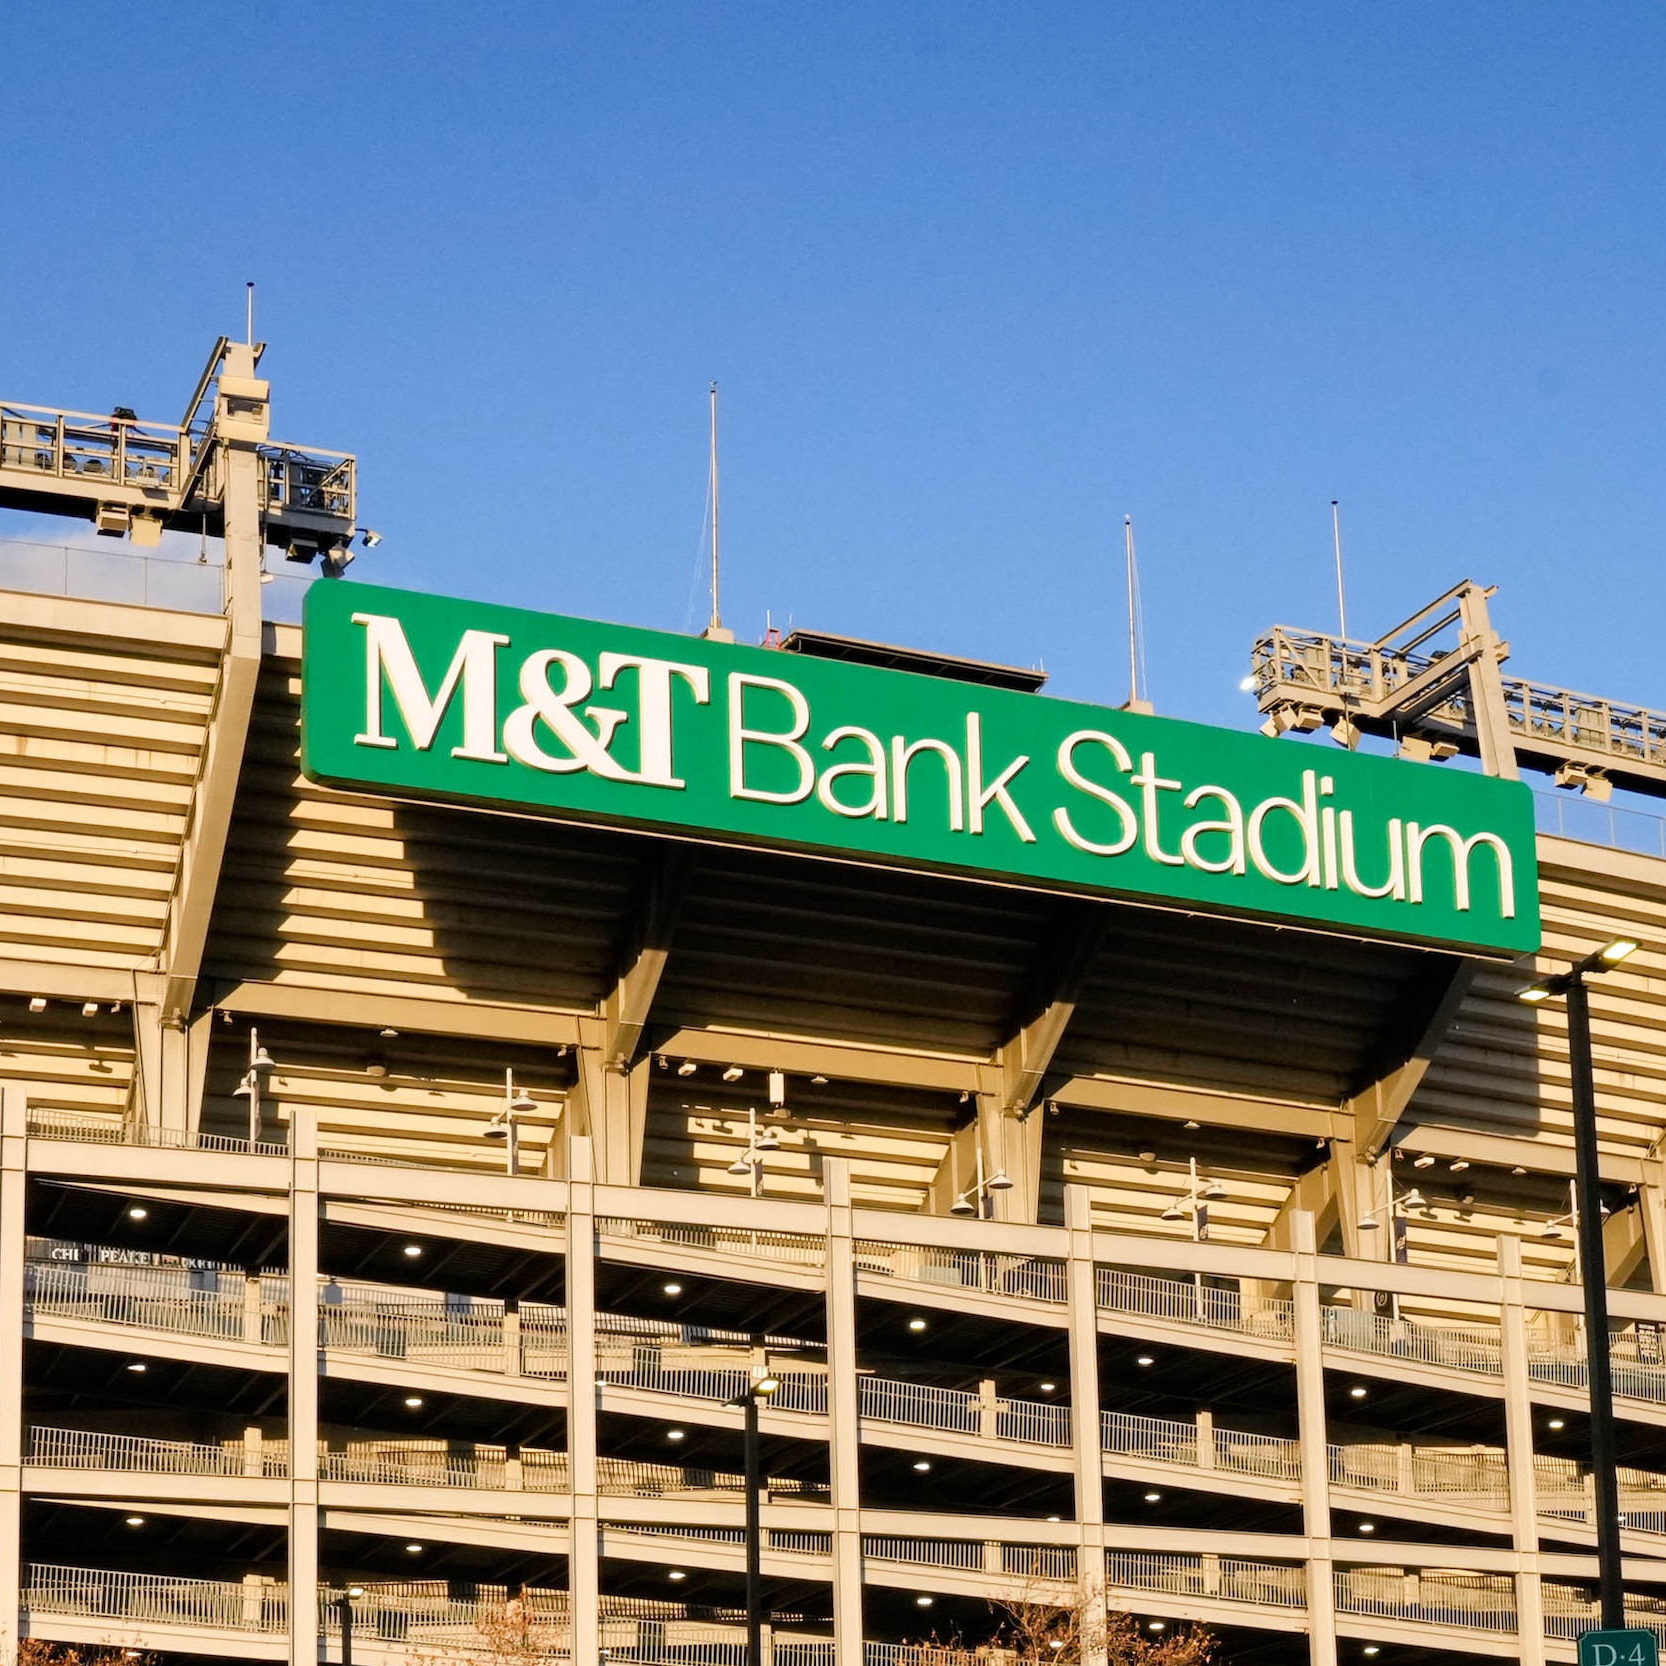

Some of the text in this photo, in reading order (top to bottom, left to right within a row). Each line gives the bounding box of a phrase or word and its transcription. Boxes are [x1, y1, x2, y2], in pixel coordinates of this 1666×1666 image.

[350, 611, 1517, 921] M&T Bank Stadium
